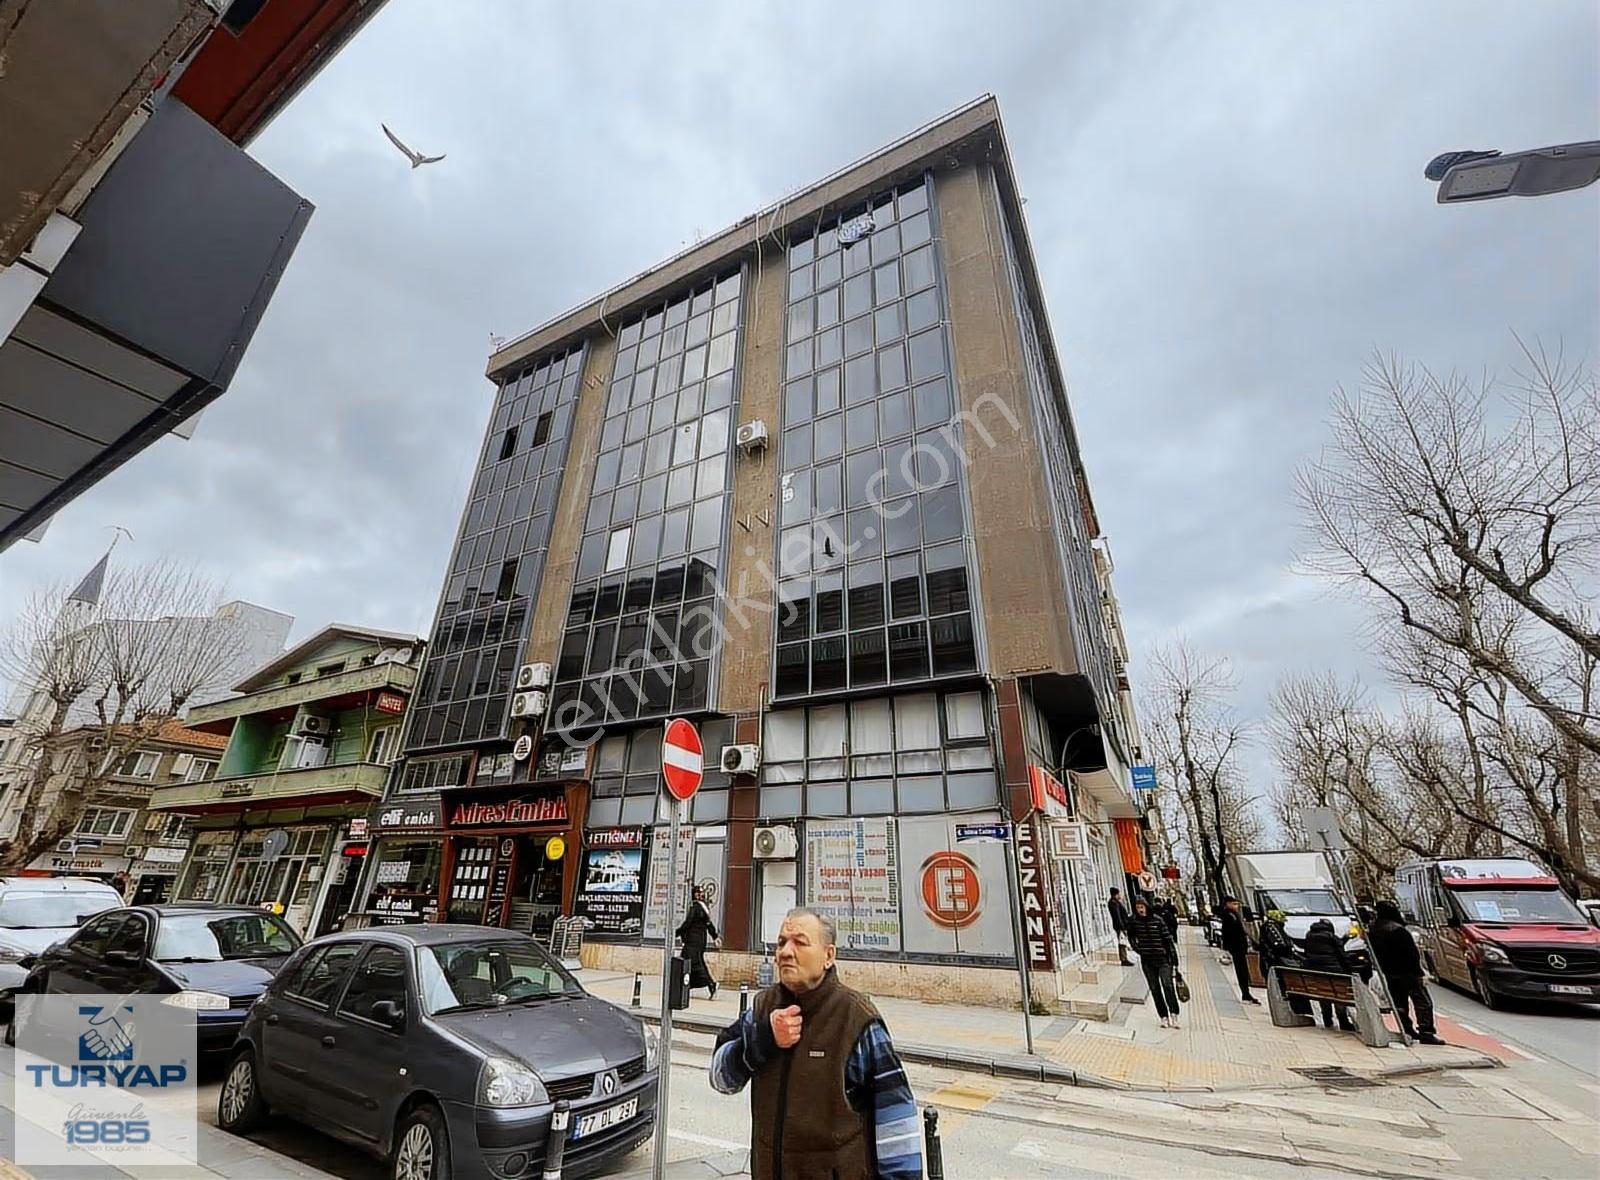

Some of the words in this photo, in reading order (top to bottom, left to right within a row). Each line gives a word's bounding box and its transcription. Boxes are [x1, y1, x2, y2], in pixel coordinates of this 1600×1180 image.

[506, 796, 569, 822] Emlak
[51, 857, 105, 869] Turmatik
[936, 867, 969, 912] E
[1016, 823, 1048, 962] ECZANE
[581, 1115, 596, 1135] 77
